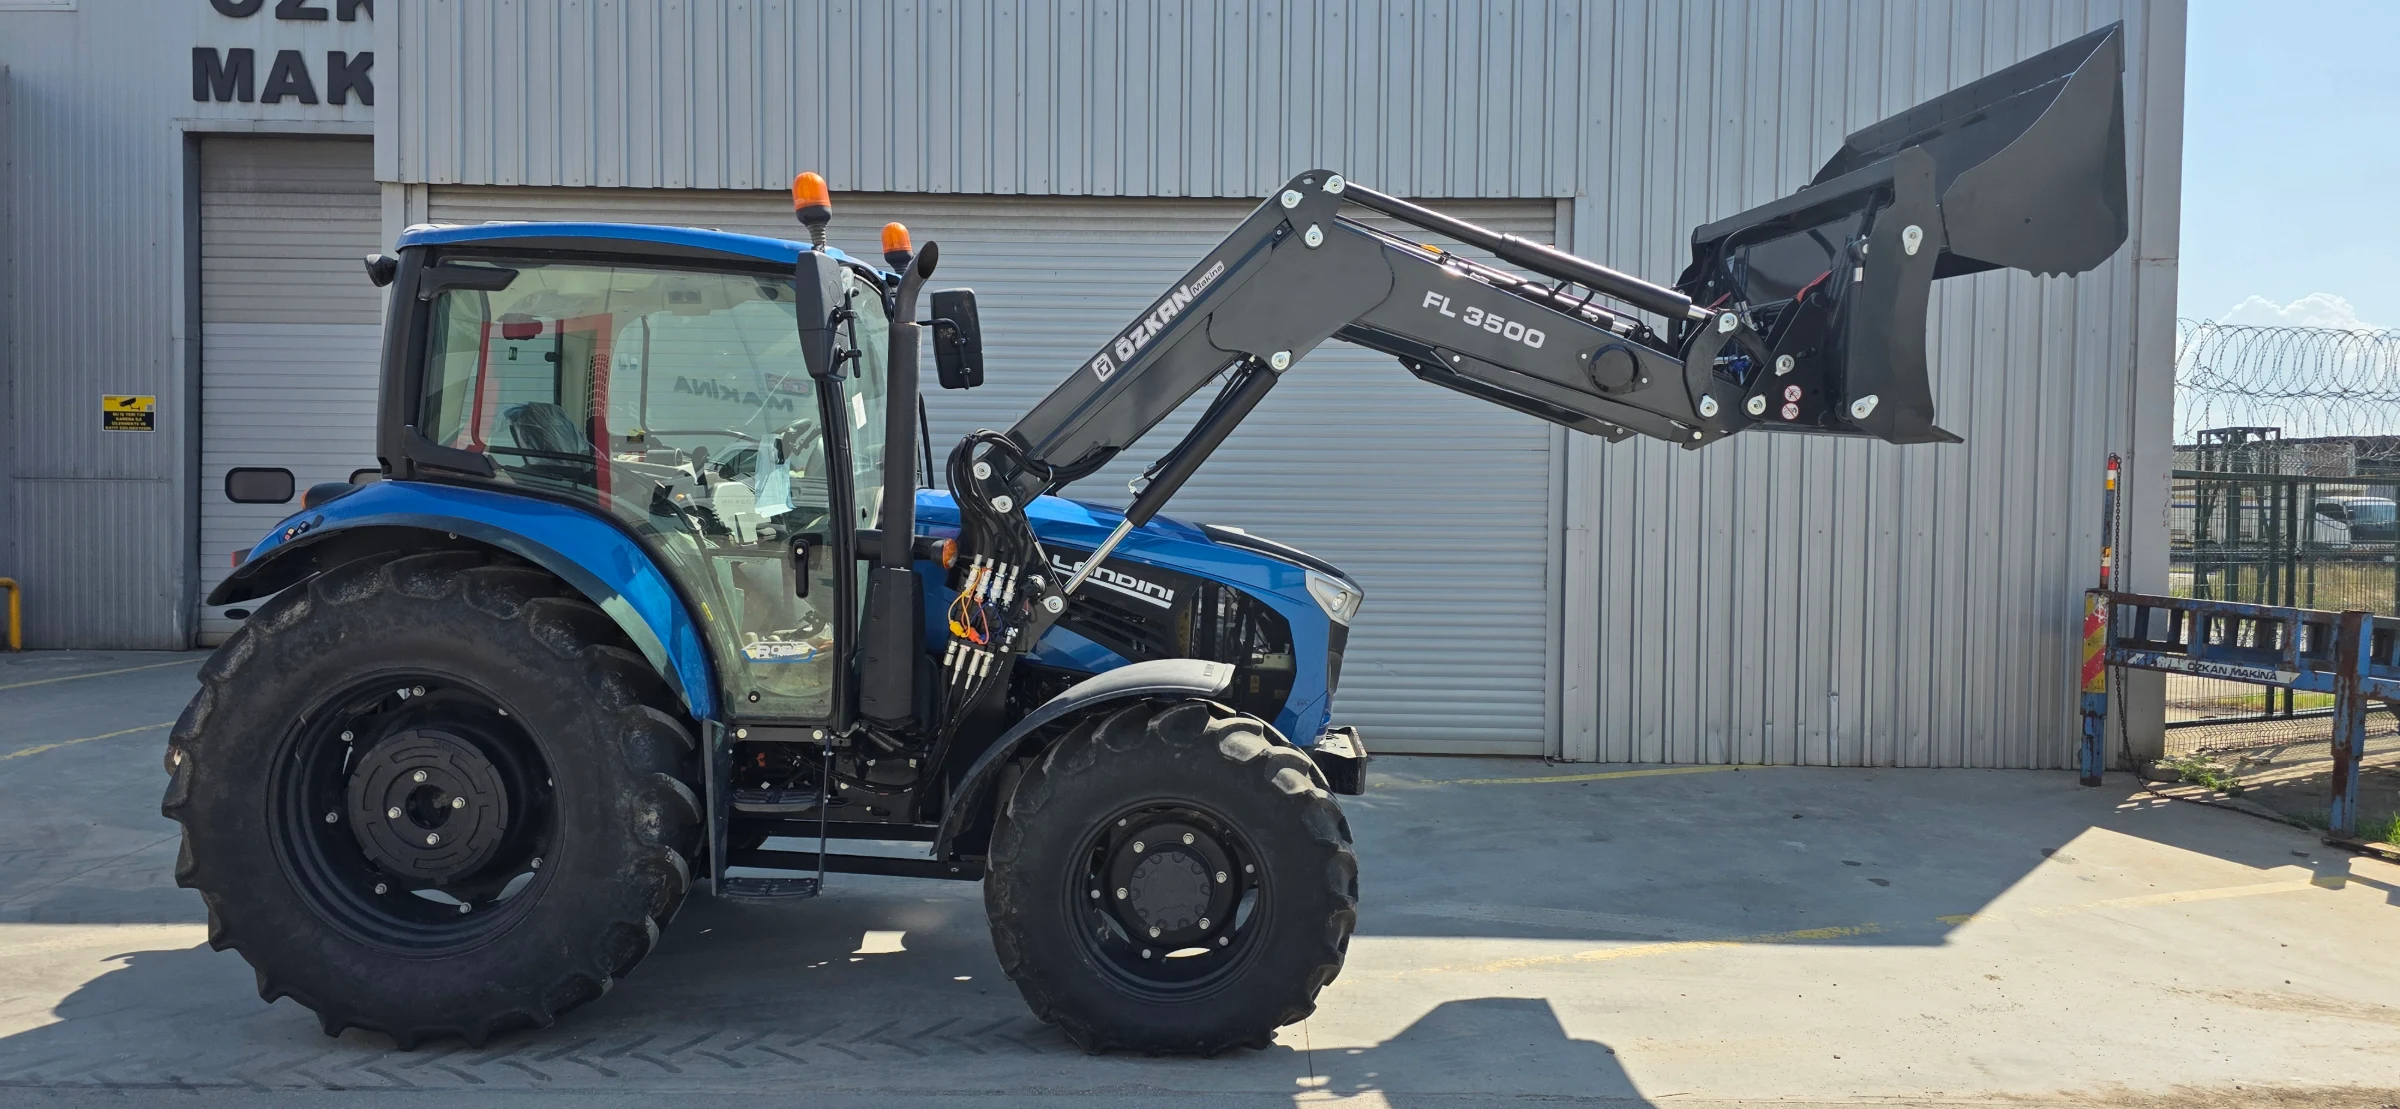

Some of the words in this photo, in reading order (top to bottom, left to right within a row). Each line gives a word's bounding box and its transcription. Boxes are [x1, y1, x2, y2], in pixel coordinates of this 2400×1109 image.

[1115, 285, 1193, 361] ÖZKAN
[1192, 264, 1223, 294] Makina
[1422, 290, 1456, 318] FL
[1463, 306, 1545, 348] 3500
[2229, 667, 2278, 681] MAKİNA
